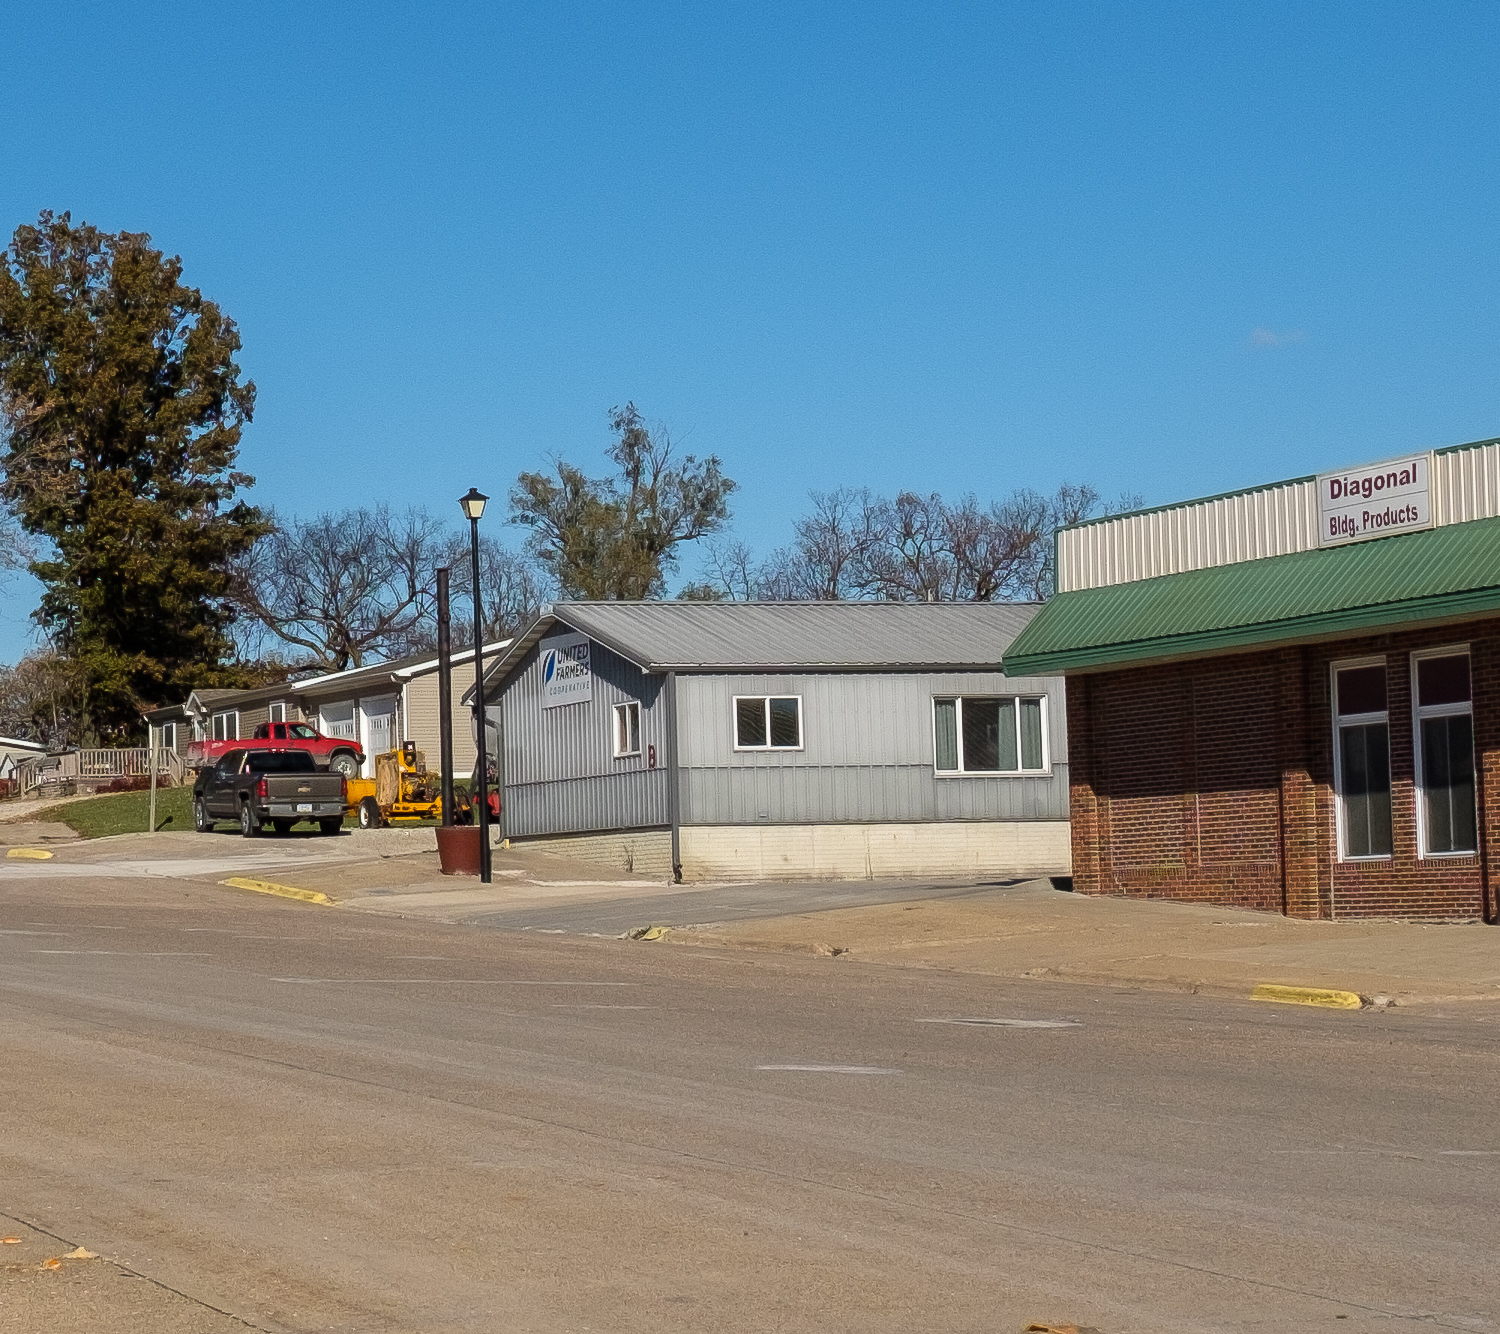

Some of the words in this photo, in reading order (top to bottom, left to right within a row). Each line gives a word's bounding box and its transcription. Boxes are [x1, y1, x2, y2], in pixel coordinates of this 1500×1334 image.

[1330, 463, 1417, 499] Diagonal
[1329, 514, 1359, 537] Bldg.
[1362, 503, 1418, 530] Products
[556, 642, 589, 665] UNITED
[555, 661, 590, 682] FARMERS
